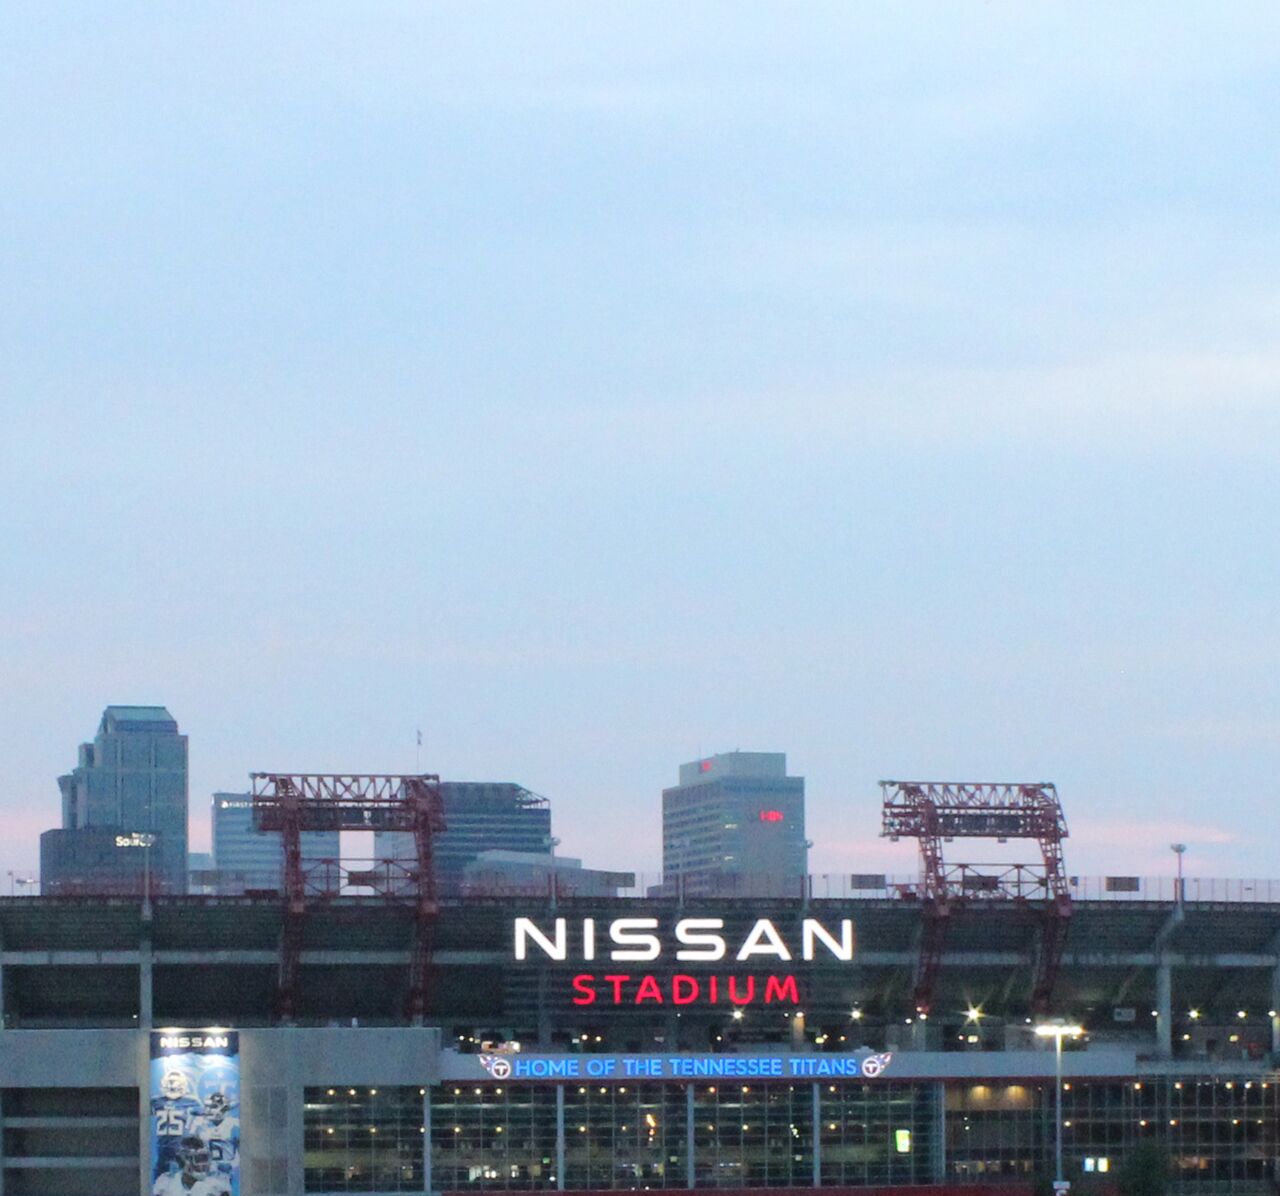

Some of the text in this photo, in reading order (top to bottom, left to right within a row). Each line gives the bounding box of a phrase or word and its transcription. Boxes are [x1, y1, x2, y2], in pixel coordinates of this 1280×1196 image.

[514, 917, 854, 961] NISSAN
[572, 974, 800, 1005] STADIUM
[159, 1037, 228, 1048] NISSAN
[515, 1057, 857, 1077] HOME OF THE TENNESSEE TITANS
[156, 1109, 184, 1136] 25
